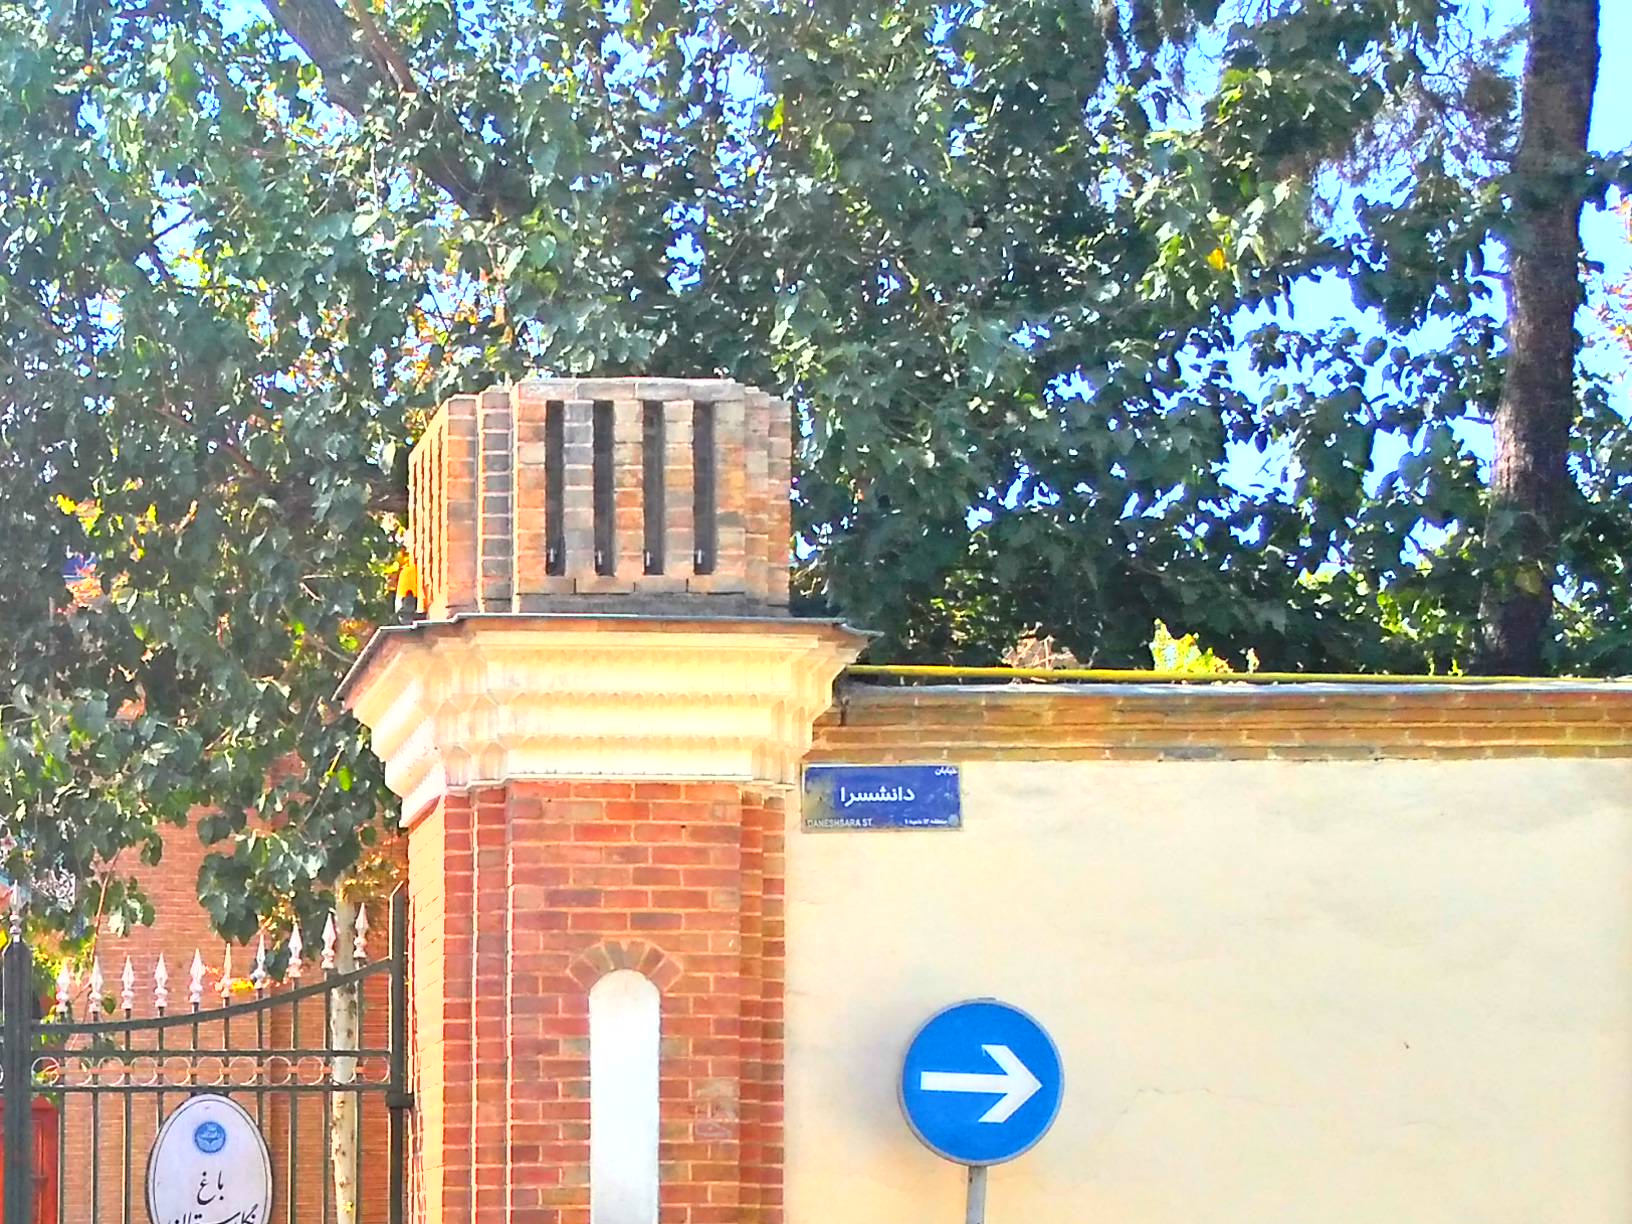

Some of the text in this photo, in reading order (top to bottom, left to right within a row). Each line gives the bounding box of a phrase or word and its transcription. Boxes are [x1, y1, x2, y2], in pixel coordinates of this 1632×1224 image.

[934, 766, 958, 776] خیابان
[840, 786, 916, 807] دانشسرا
[806, 817, 873, 828] DANESHSARA ST
[196, 1170, 225, 1206] باغ
